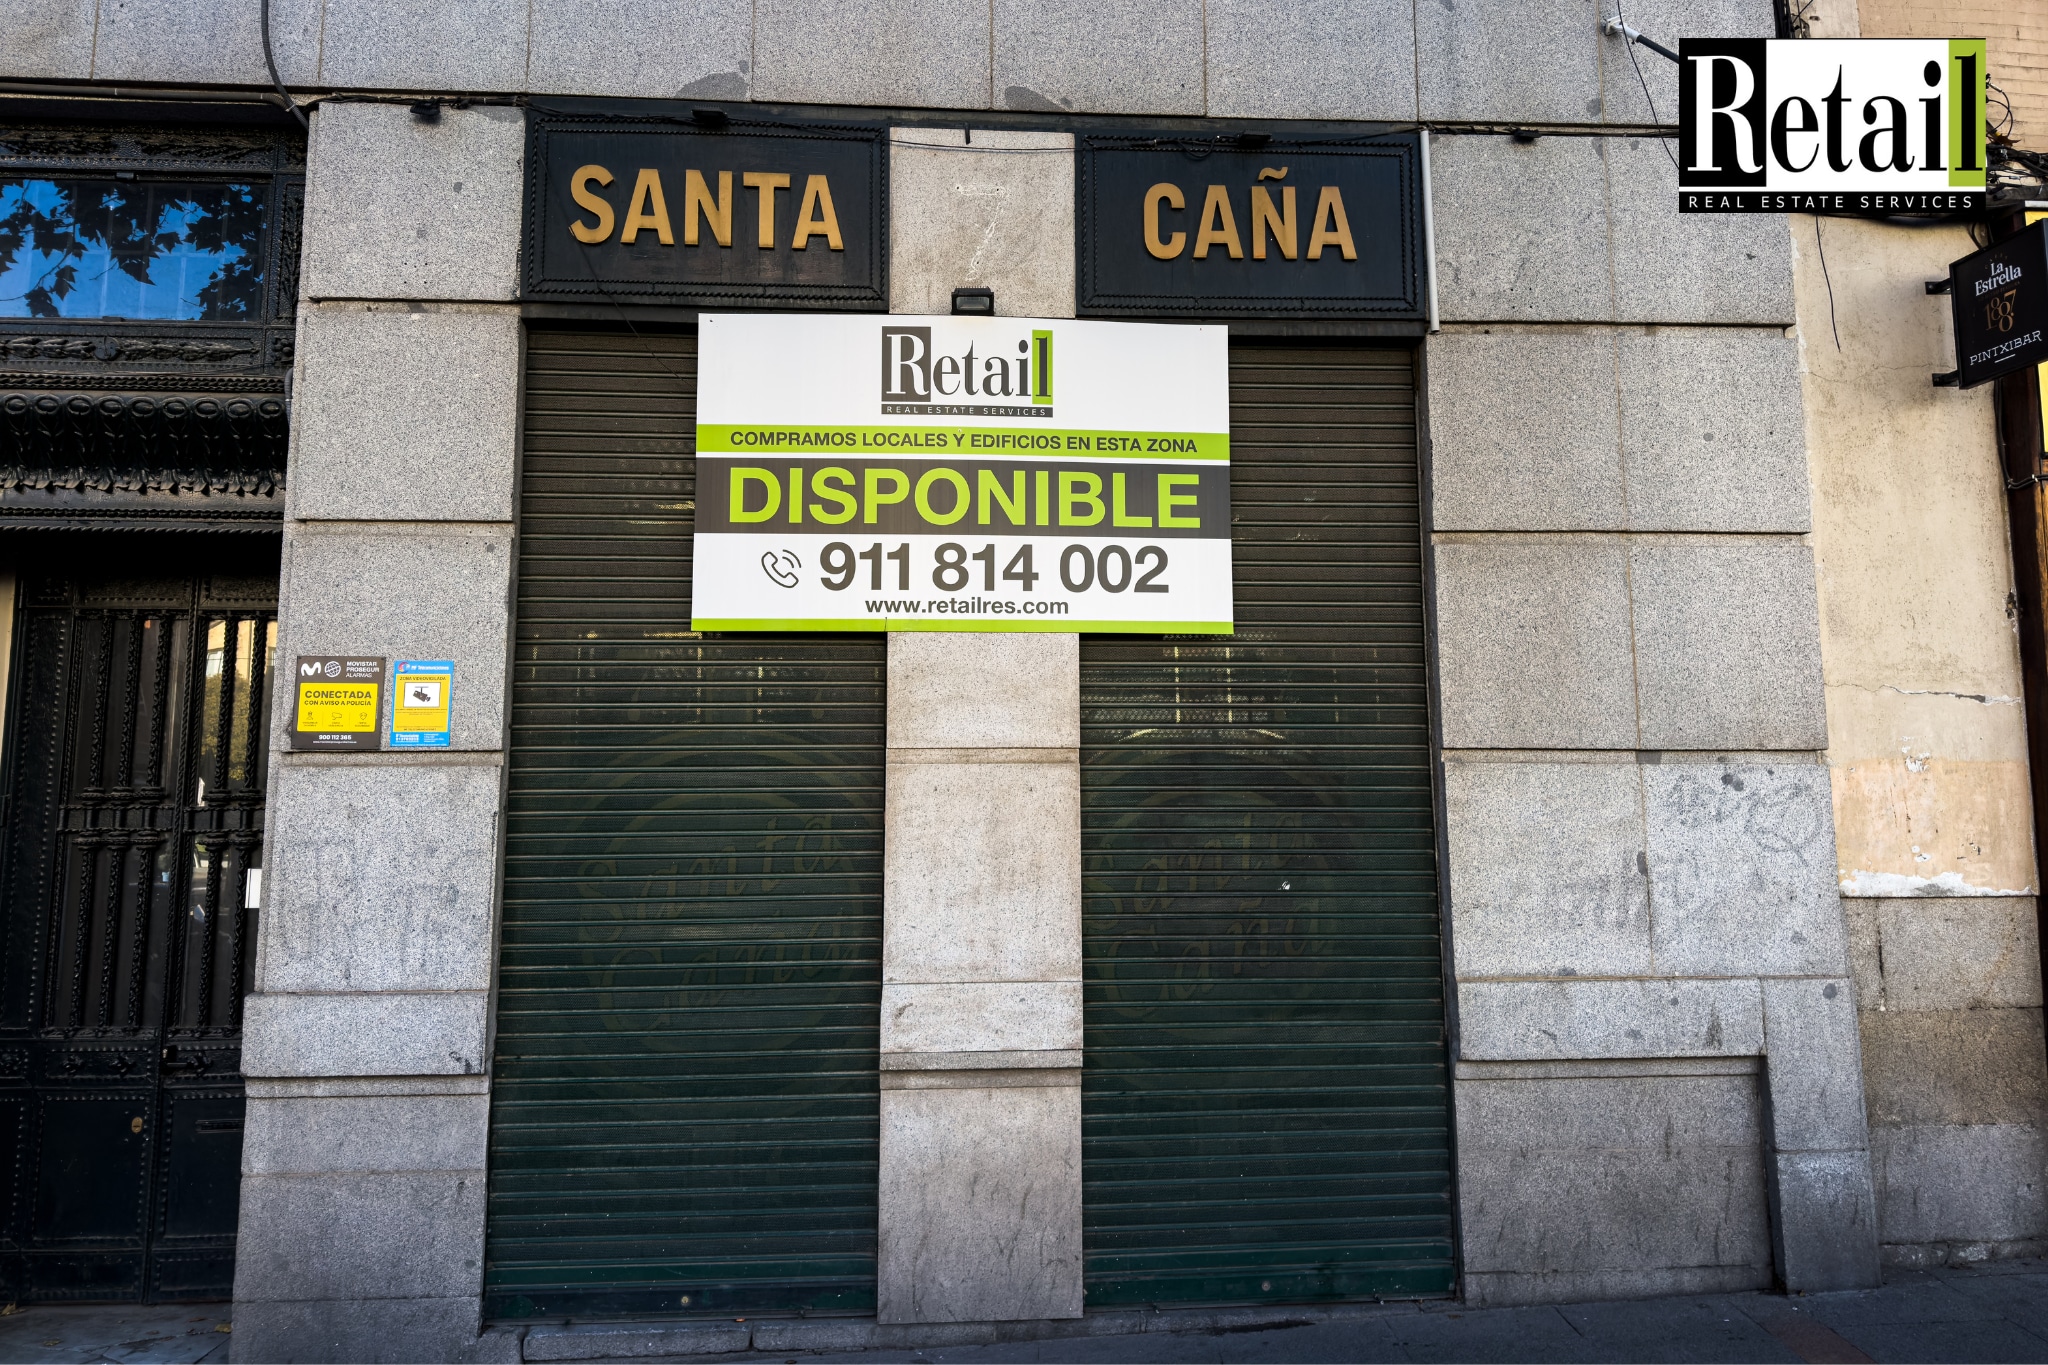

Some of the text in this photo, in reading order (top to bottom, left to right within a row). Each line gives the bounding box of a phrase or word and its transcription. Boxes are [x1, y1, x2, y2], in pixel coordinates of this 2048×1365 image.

[569, 163, 844, 251] SANTA
[1143, 166, 1358, 261] CAÑA
[1975, 265, 2022, 297] Estrella
[1990, 262, 2004, 277] La
[1969, 330, 2043, 366] PINTXIBAR
[886, 334, 1053, 398] Retail
[886, 405, 1047, 417] REAL ESTATE SERVICES
[730, 431, 1198, 453] COMPRAMOS LOCALES Y EDIFICIOS EN ESTA ZONA
[728, 467, 1201, 529] DISPONIBLE
[819, 541, 1170, 594] 911 814 002
[865, 597, 1069, 616] www.retailres.com
[305, 690, 372, 699] CONECTADA
